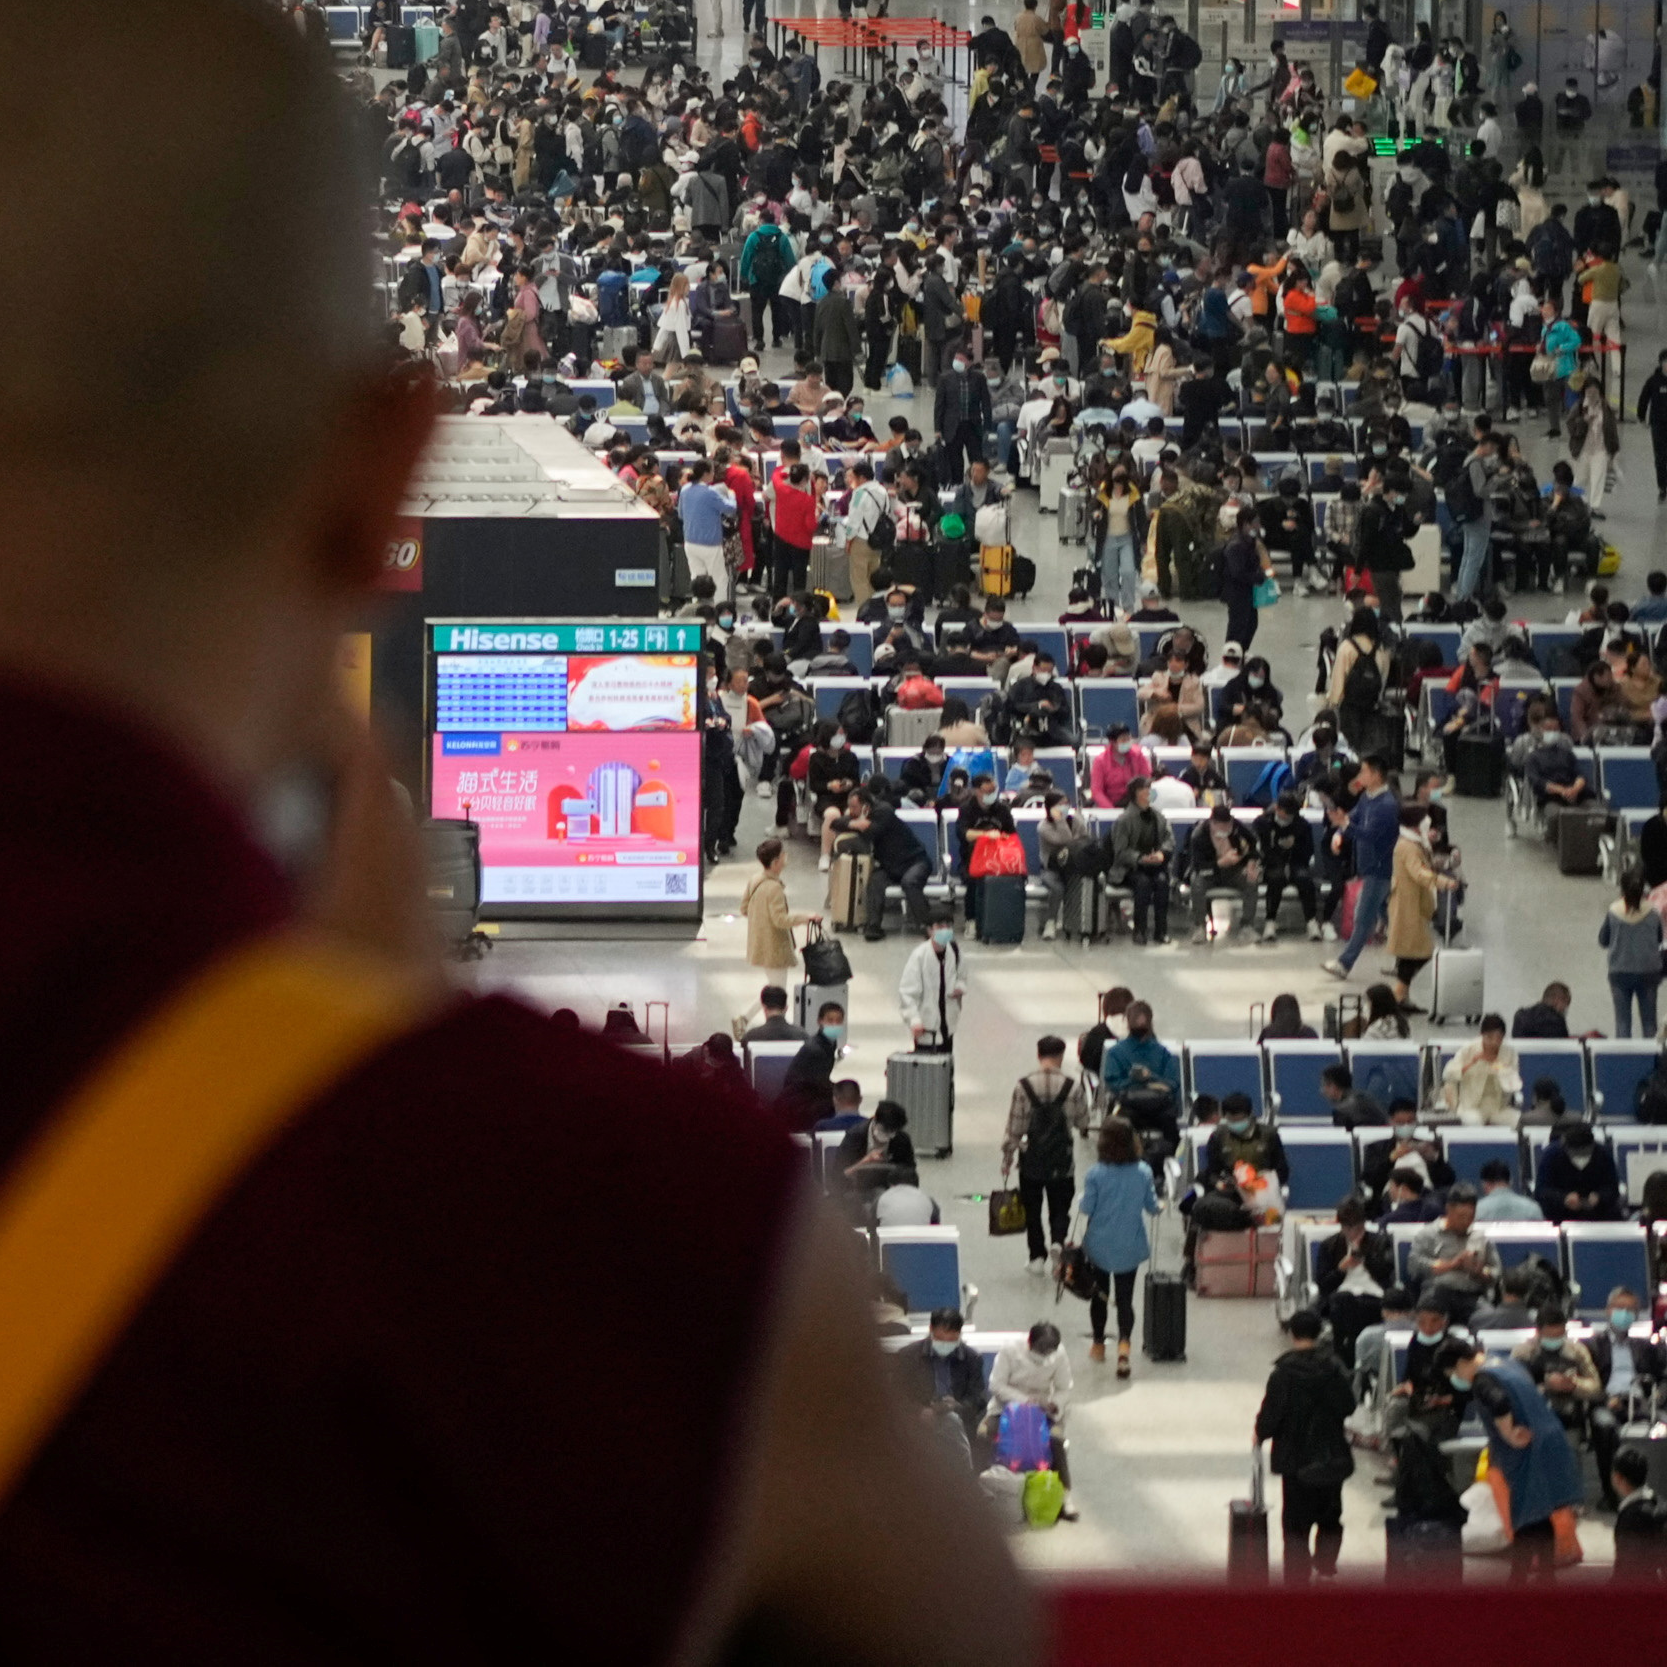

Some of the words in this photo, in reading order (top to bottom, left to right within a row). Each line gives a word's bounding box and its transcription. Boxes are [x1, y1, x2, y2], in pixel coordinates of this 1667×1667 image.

[450, 627, 559, 651] Hisense
[609, 628, 639, 650] 1-25
[446, 740, 474, 749] KELON
